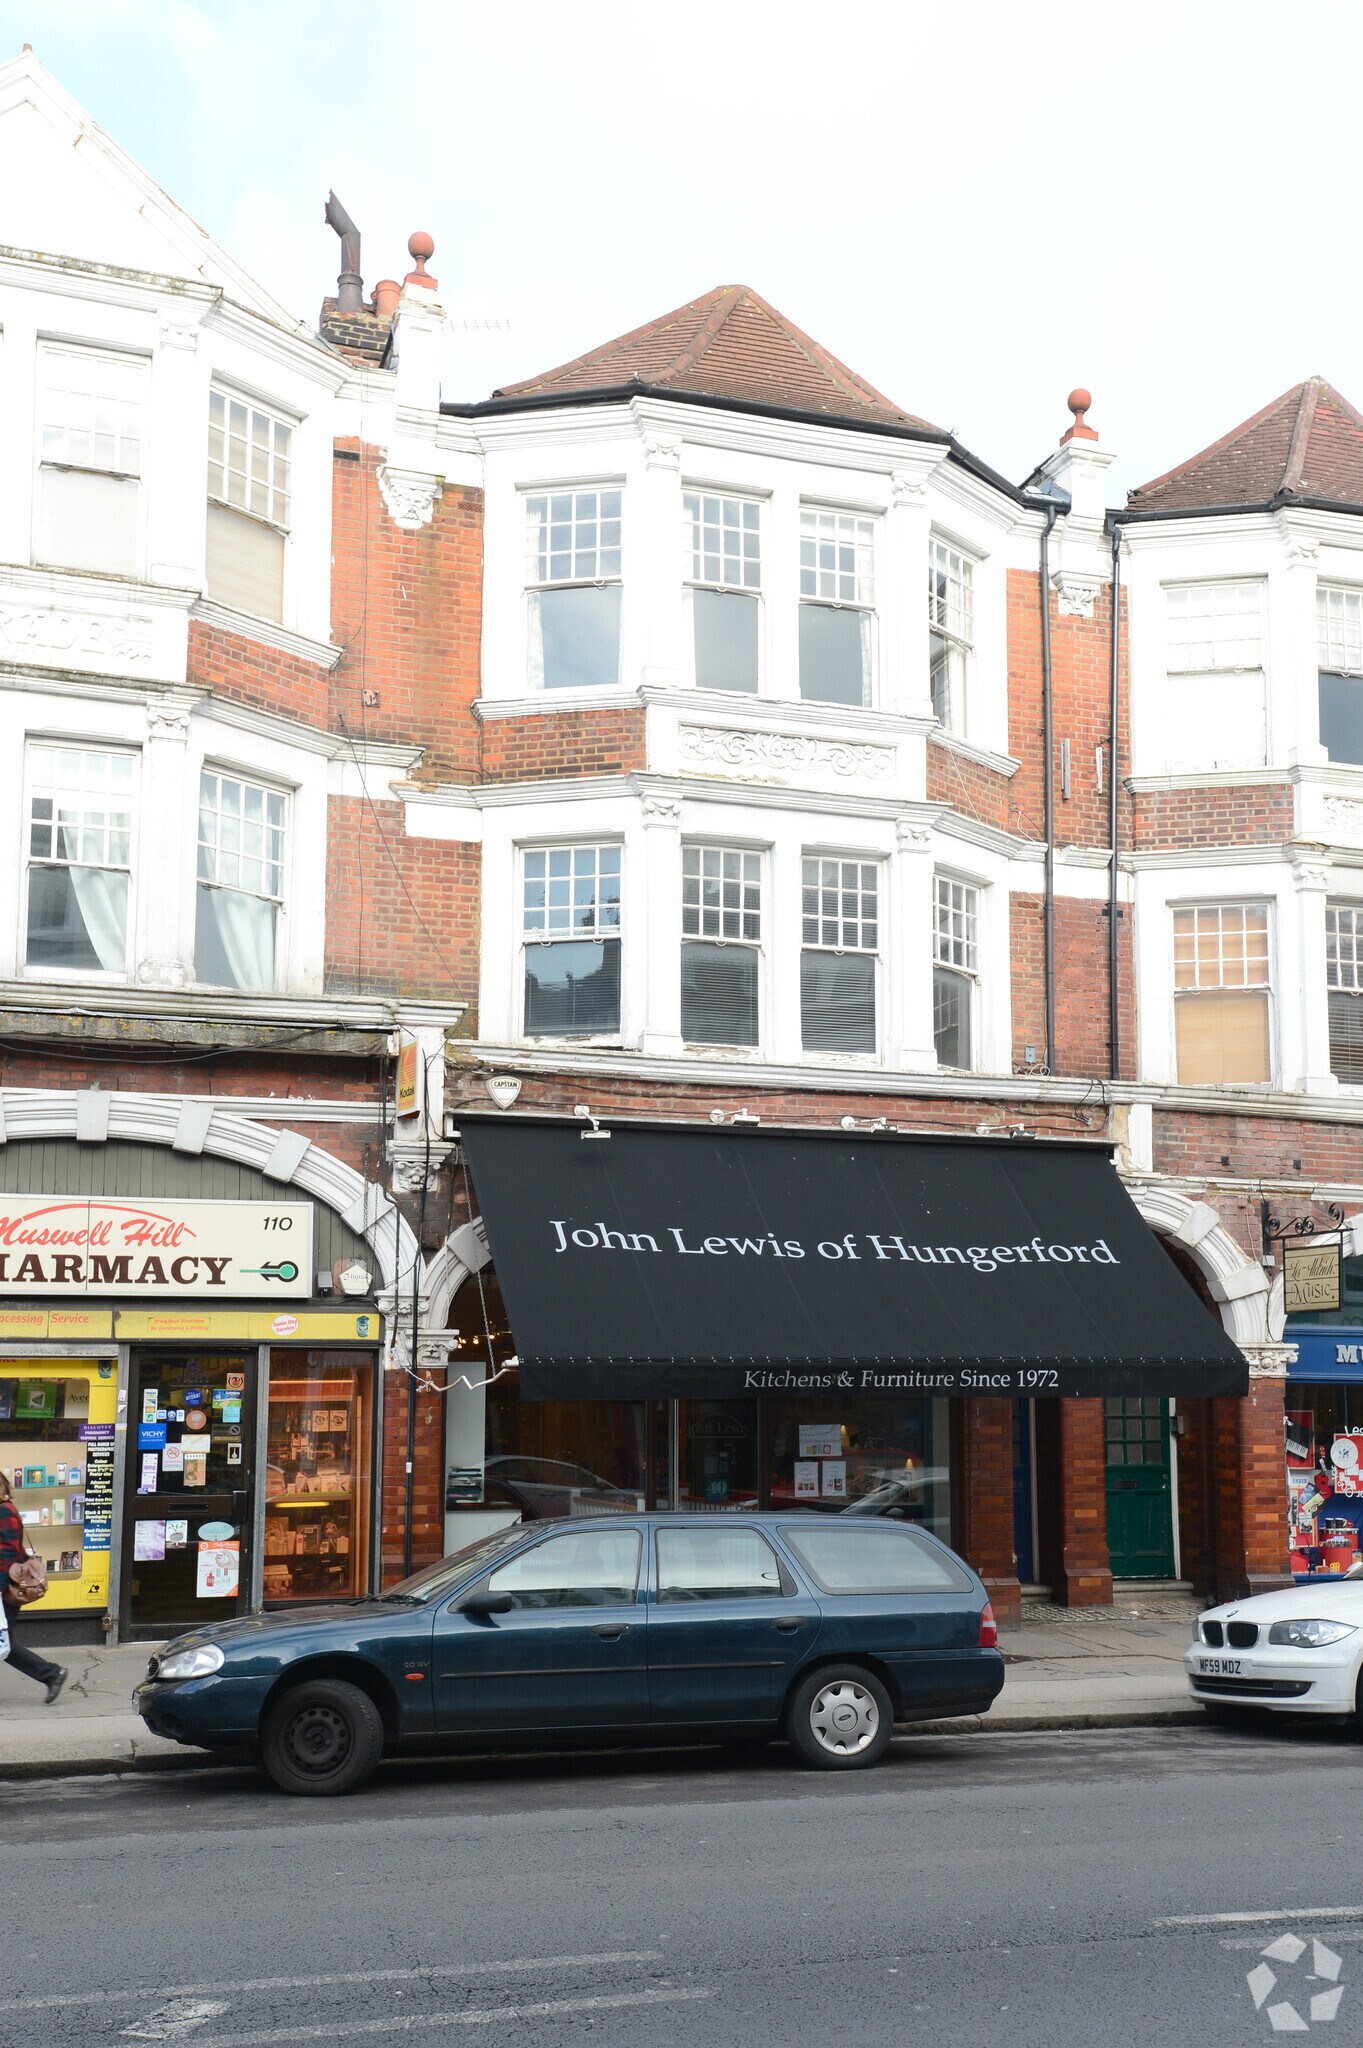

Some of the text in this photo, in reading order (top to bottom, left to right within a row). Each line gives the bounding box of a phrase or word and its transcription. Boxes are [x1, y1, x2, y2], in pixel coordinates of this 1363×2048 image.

[493, 1080, 518, 1088] CAPSTAN
[400, 1086, 415, 1099] Kodak
[263, 1217, 292, 1231] 110
[0, 1216, 184, 1247] Muswell Hill
[549, 1220, 1121, 1272] John Lewis of Hungerford
[51, 1313, 89, 1323] Service
[288, 1319, 298, 1327] Day
[743, 1369, 1059, 1388] Kitchens & Furniture Since 1972
[717, 1421, 749, 1433] Lewis
[1222, 1660, 1241, 1674] MDZ
